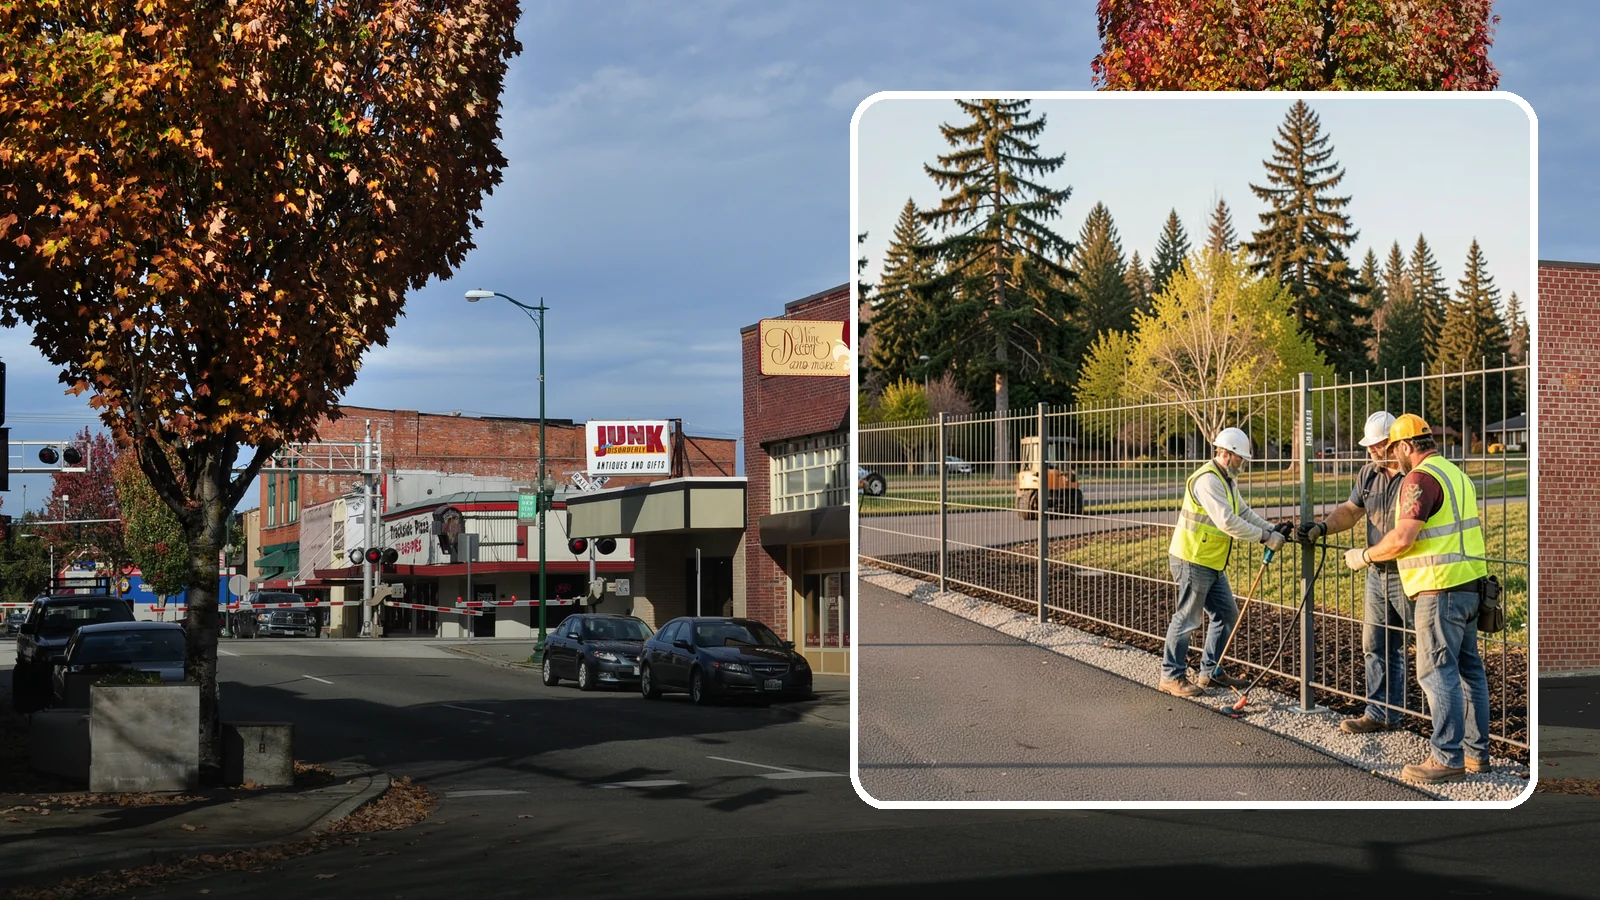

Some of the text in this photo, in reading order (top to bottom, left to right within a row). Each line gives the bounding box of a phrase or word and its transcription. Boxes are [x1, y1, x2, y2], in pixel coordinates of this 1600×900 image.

[595, 425, 665, 457] JUNK
[607, 446, 646, 454] DISORDERLY
[596, 460, 665, 470] ANTIQUES AND GIFTS
[573, 473, 590, 492] RAIL
[414, 519, 429, 535] Pizza
